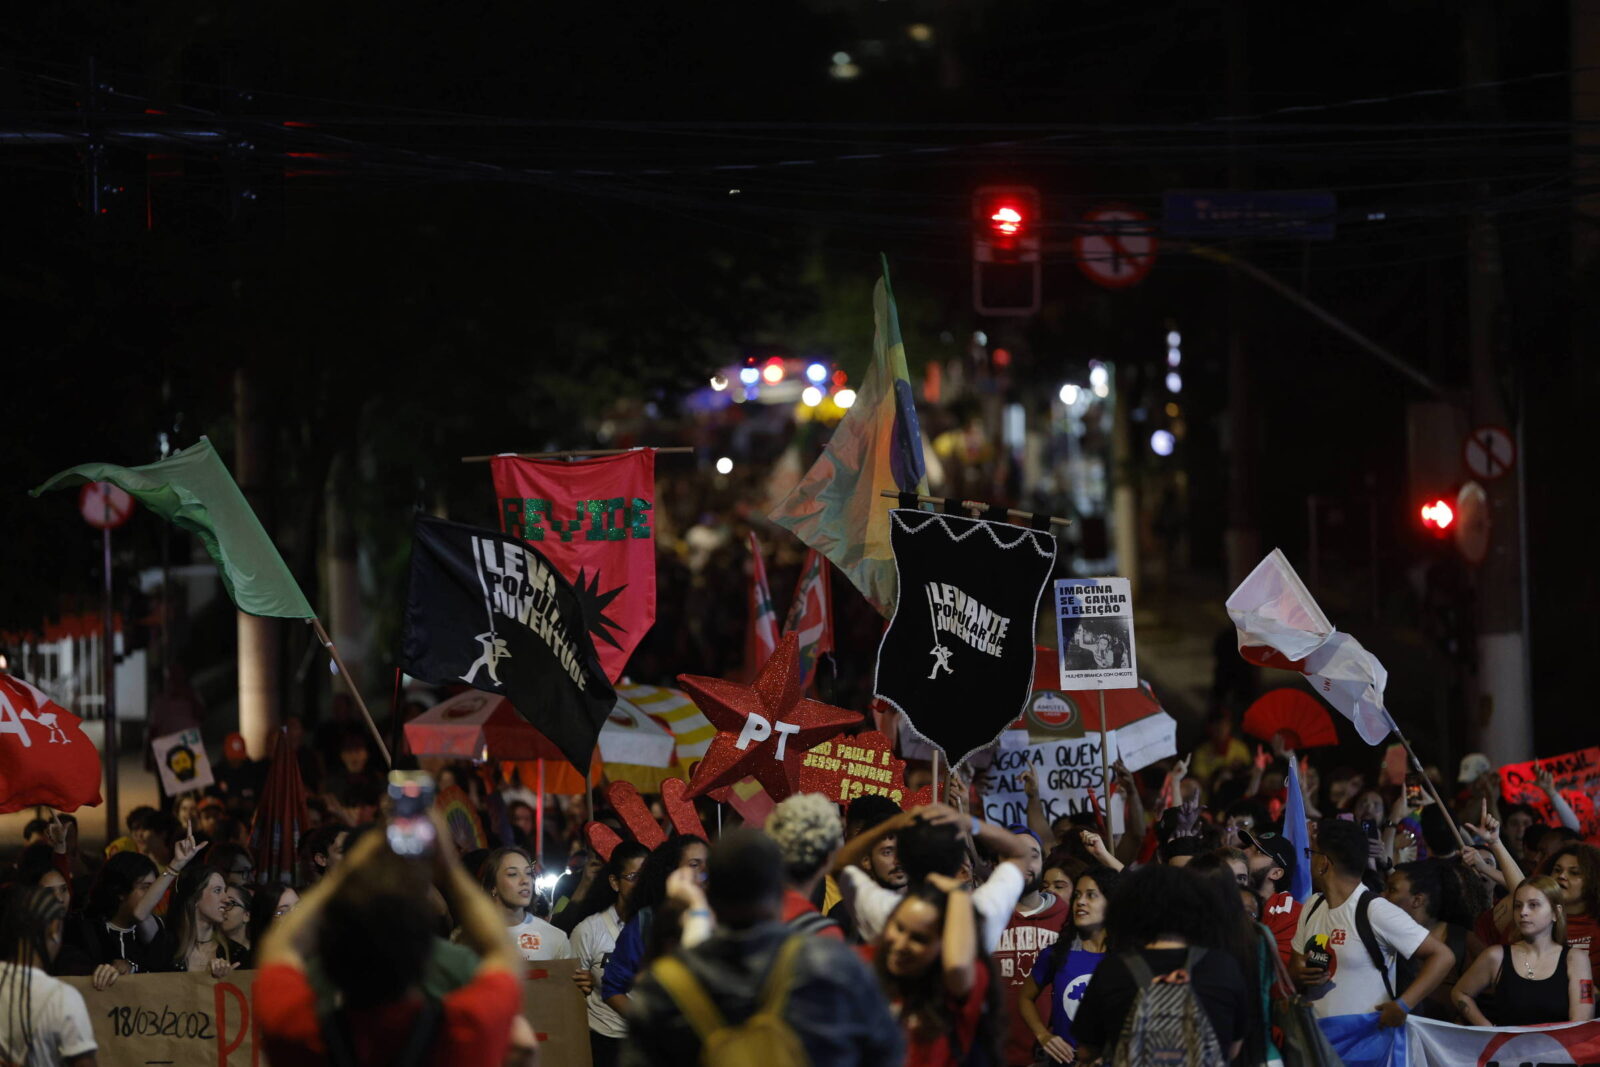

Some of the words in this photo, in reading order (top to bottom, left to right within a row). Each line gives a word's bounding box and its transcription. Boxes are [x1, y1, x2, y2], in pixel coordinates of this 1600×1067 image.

[503, 497, 652, 542] REVIDE
[1059, 585, 1112, 596] IMAGINA
[1060, 596, 1075, 605] SE
[1084, 594, 1127, 604] GANHA
[929, 581, 1011, 639] LEVANTE
[933, 602, 987, 641] POPULAR
[1061, 606, 1069, 615] A
[1071, 602, 1121, 615] ELEIÇÃO
[493, 588, 588, 692] JUVENTUDE
[937, 614, 1003, 658] JUVENTUDE
[735, 712, 800, 761] PT
[836, 743, 871, 764] PAULO
[989, 749, 1043, 771] AGORA
[1056, 743, 1102, 767] QUEM
[1048, 766, 1117, 790] GROSSO
[1000, 958, 1014, 977] 19
[108, 1005, 216, 1040] 18/03/2002
